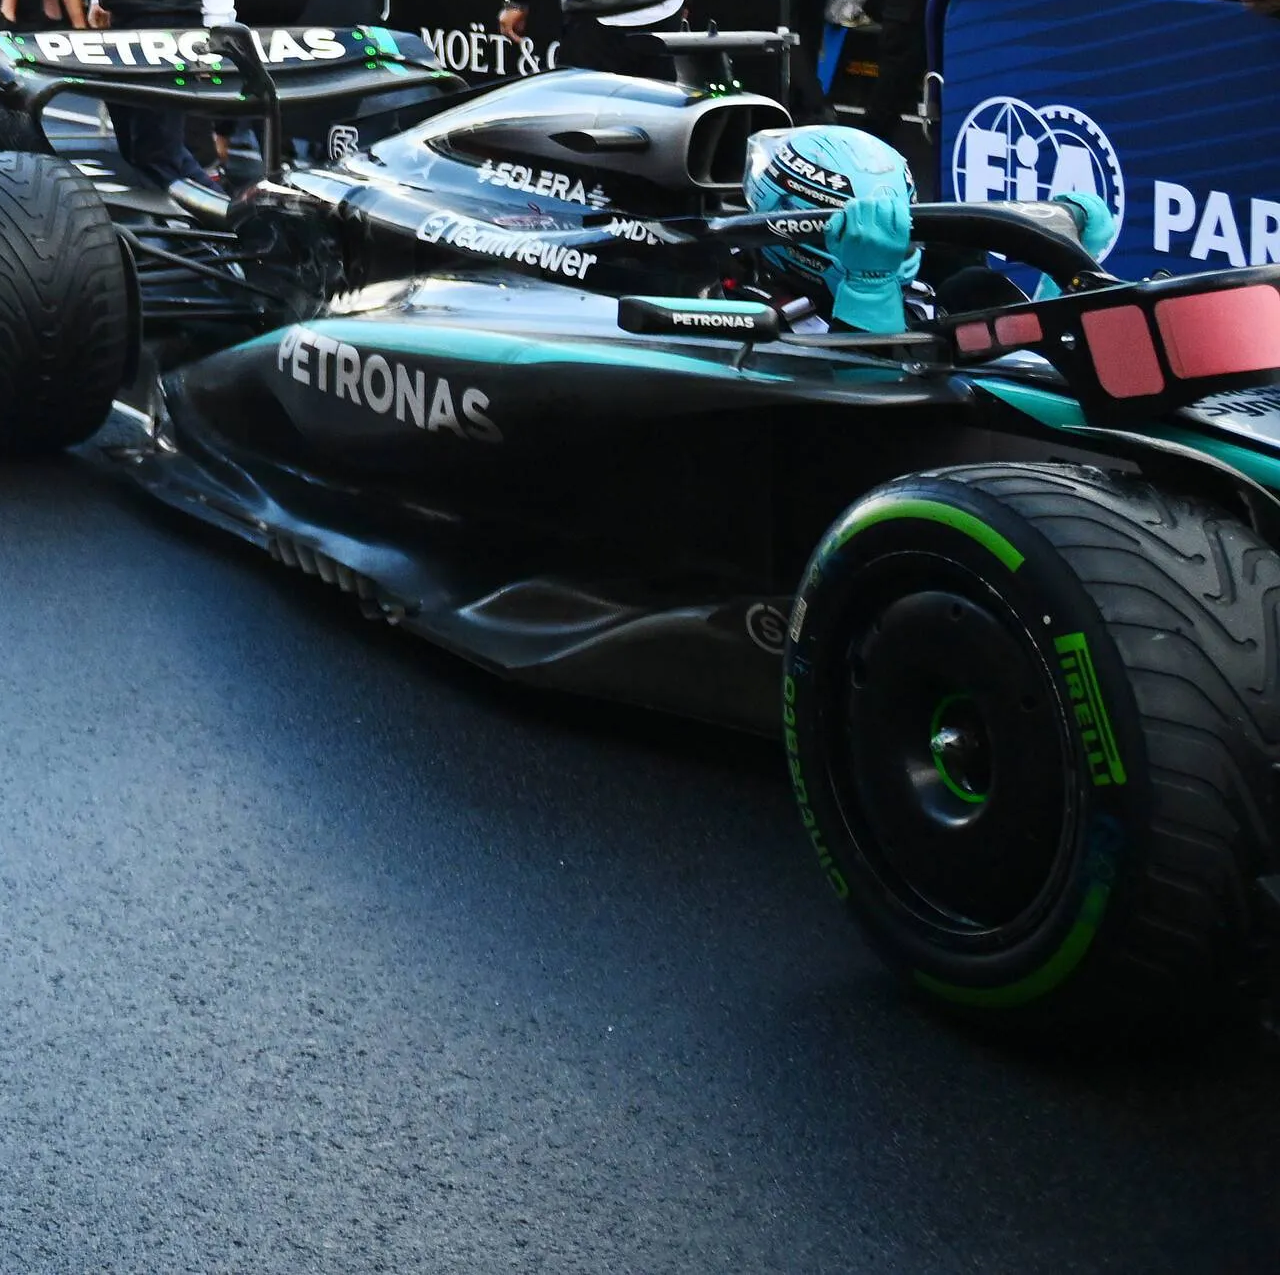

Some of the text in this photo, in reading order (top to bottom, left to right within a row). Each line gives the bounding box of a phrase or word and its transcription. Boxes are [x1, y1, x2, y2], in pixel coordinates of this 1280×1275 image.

[420, 23, 513, 75] MOËT
[517, 36, 541, 76] &
[497, 162, 587, 205] SOLERA
[444, 224, 597, 280] TeamViewer
[672, 312, 754, 328] PETRONAS
[278, 324, 503, 443] PETRONAS
[1053, 632, 1127, 786] PIRELLI
